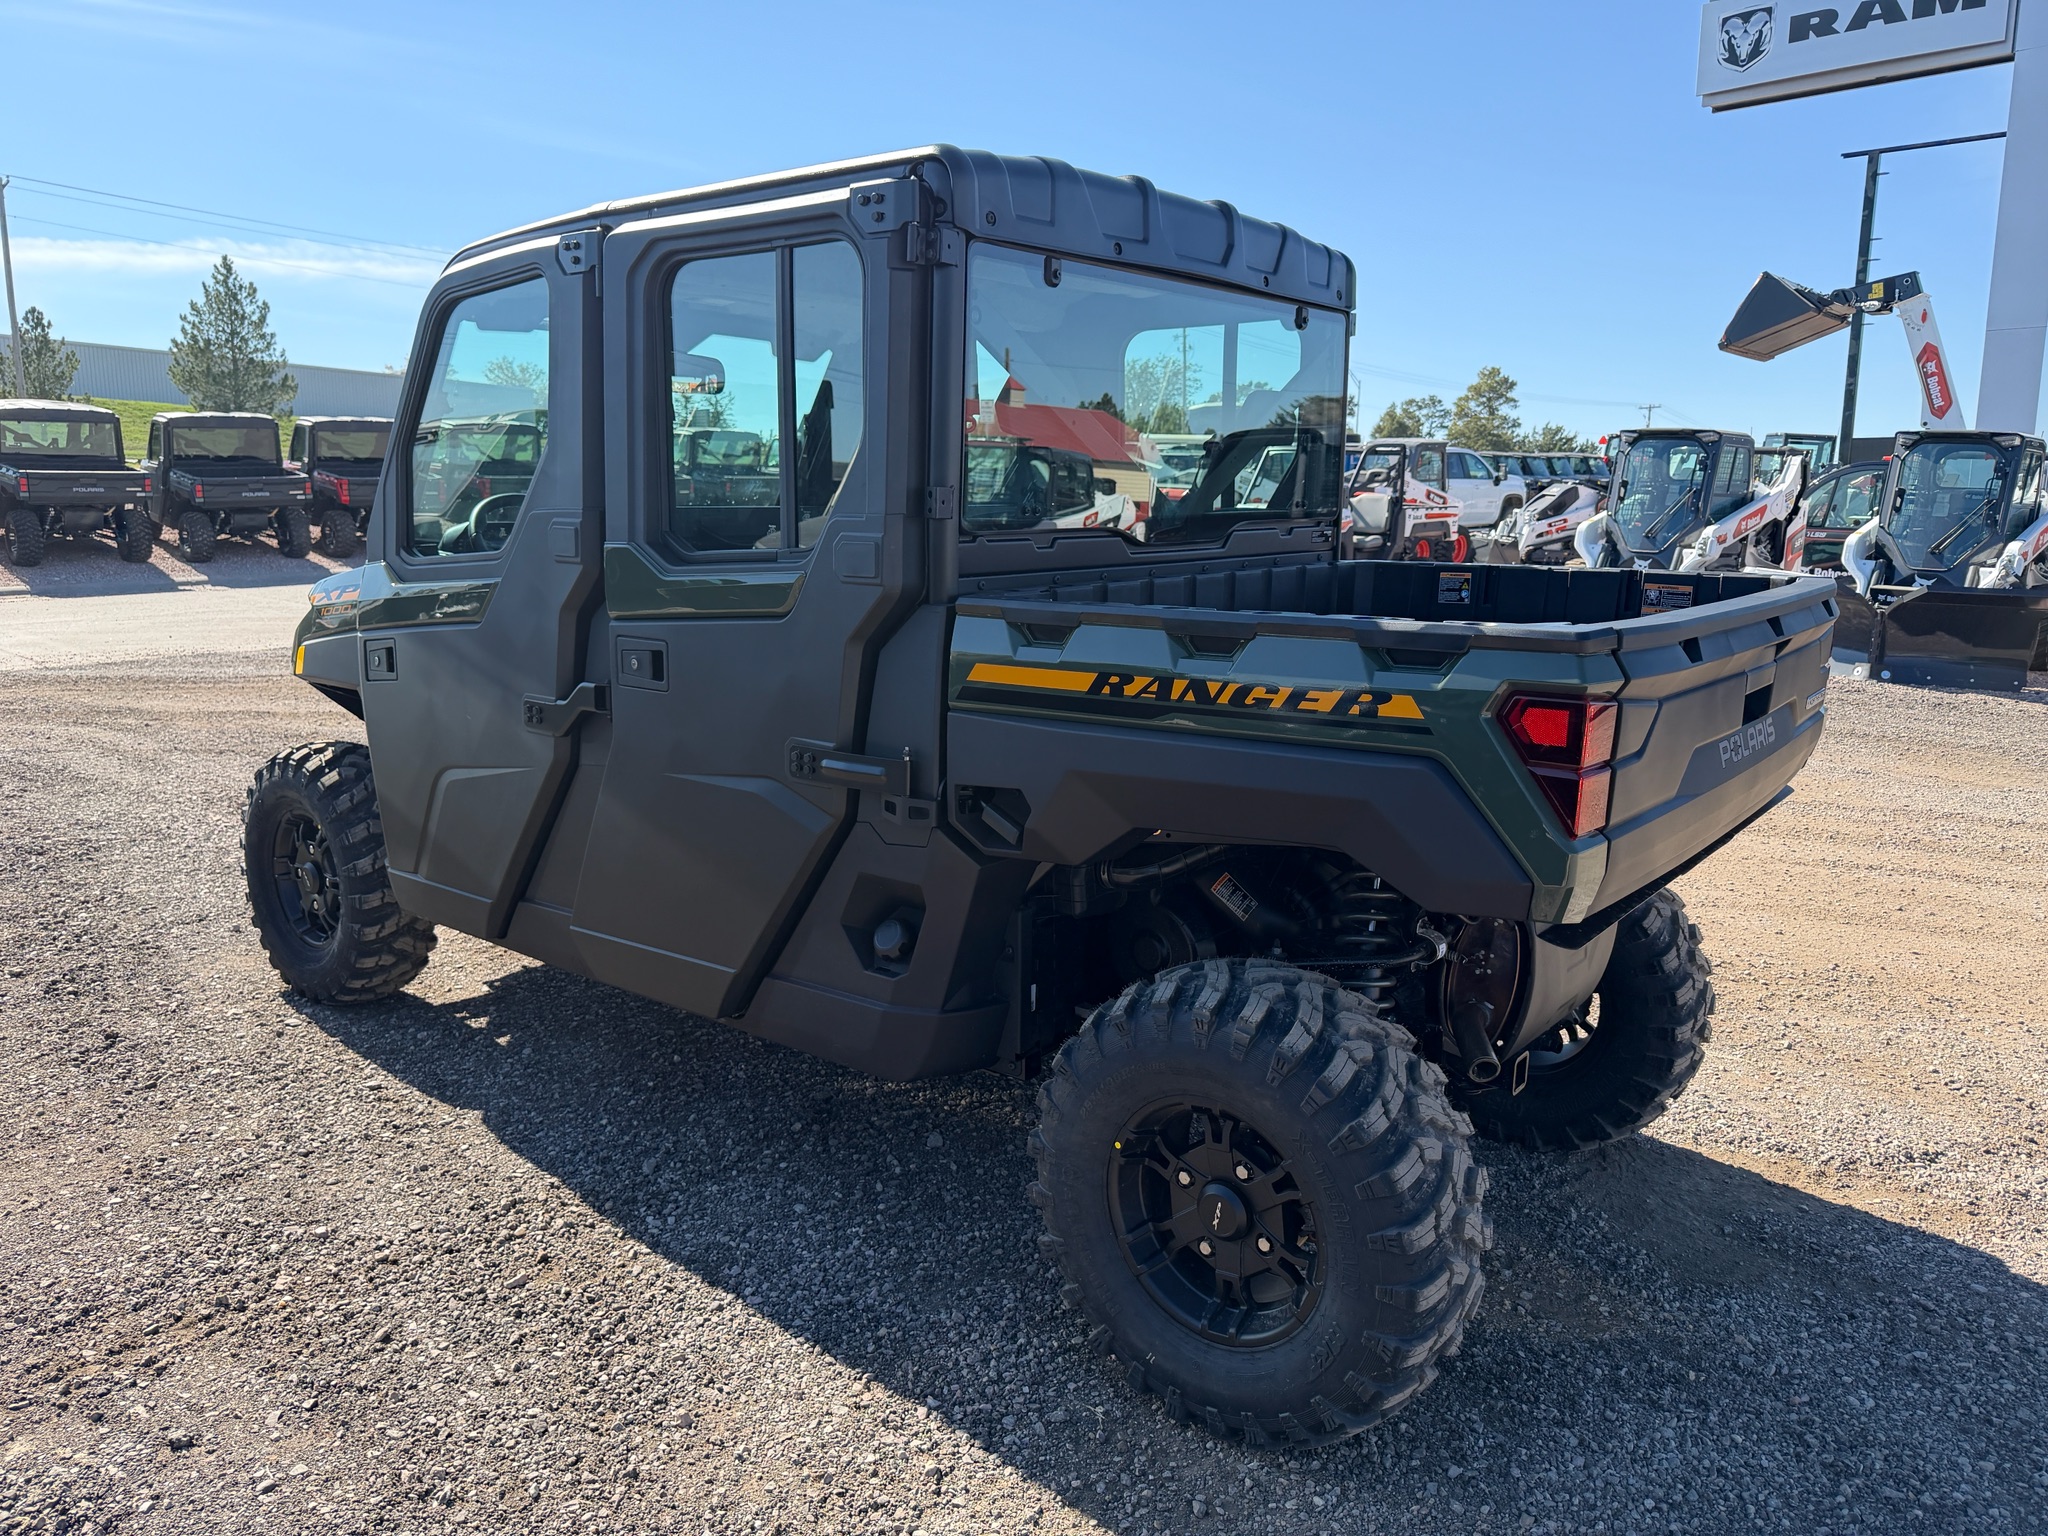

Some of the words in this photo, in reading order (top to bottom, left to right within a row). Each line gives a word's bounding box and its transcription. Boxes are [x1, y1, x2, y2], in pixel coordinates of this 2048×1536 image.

[1926, 375, 1945, 409] Bobcat
[316, 583, 362, 604] XP
[320, 605, 352, 617] 1000
[1085, 671, 1394, 719] RANGER
[1718, 716, 1776, 769] POLARIS
[1288, 1127, 1361, 1301] X-TERRAIN
